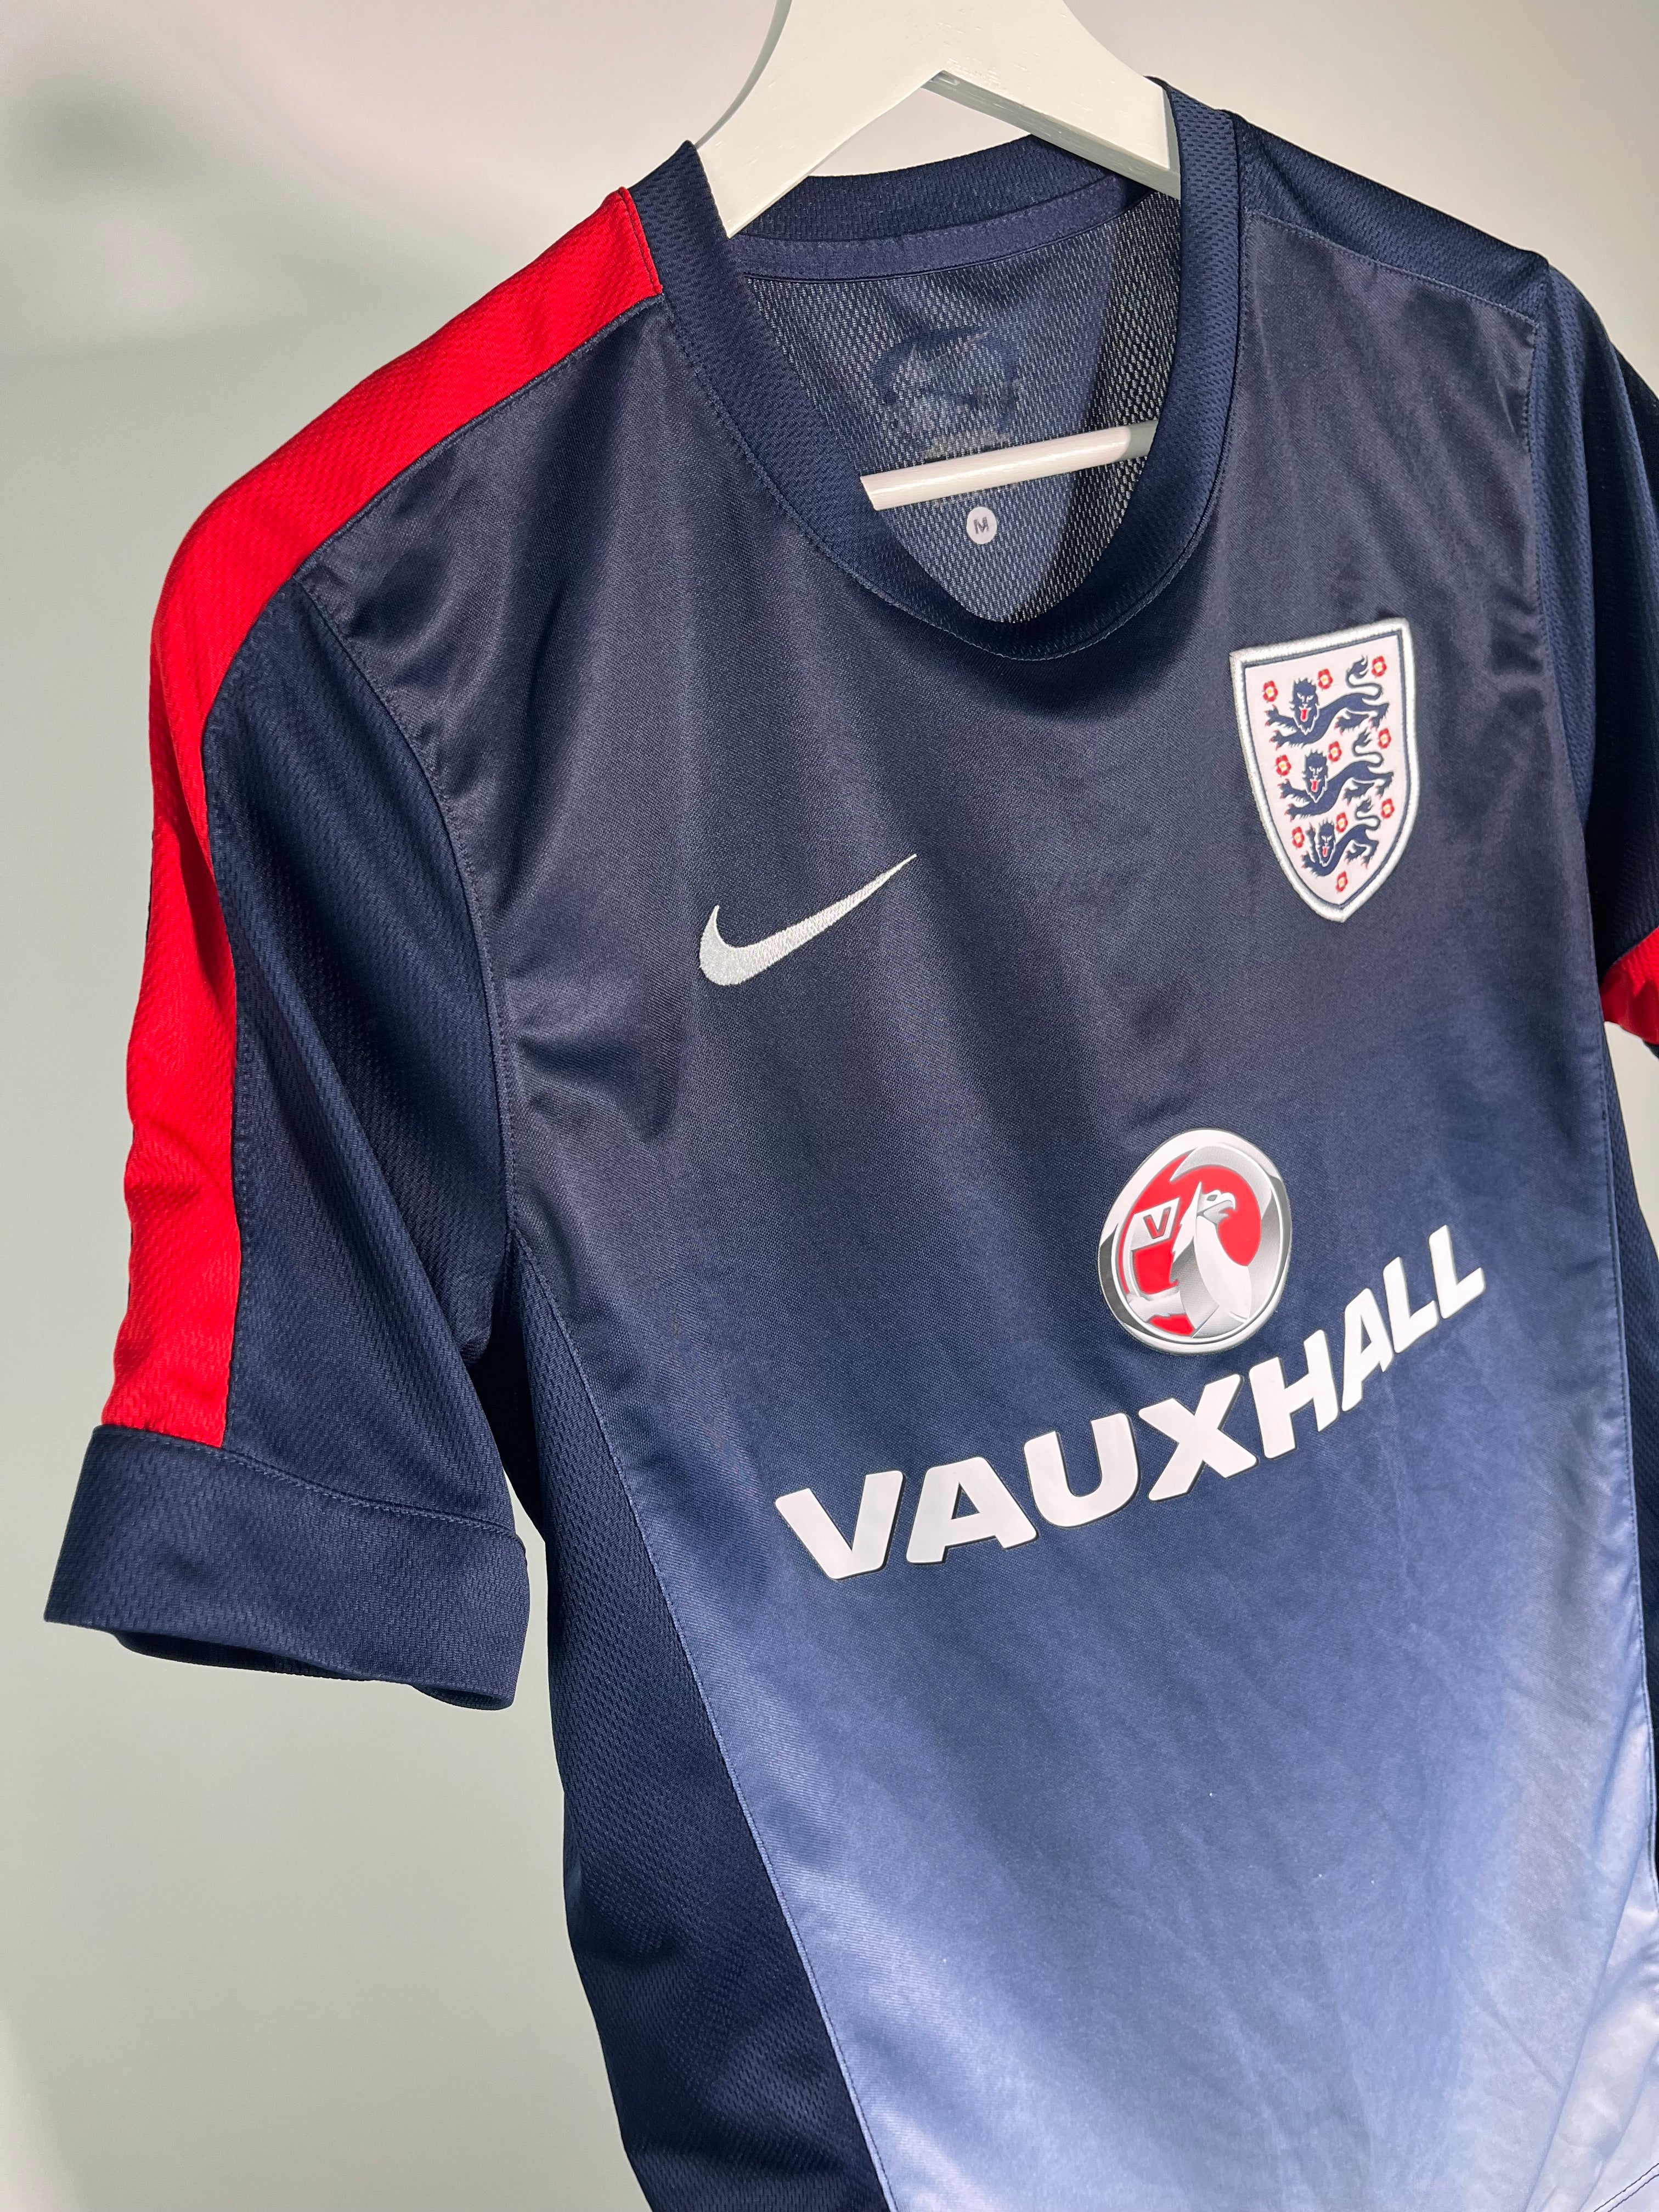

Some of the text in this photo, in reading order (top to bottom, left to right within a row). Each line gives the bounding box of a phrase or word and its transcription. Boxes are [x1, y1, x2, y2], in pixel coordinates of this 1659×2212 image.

[974, 517, 989, 534] M
[1143, 1207, 1171, 1239] V
[775, 1225, 1486, 1580] VAUXHALL
